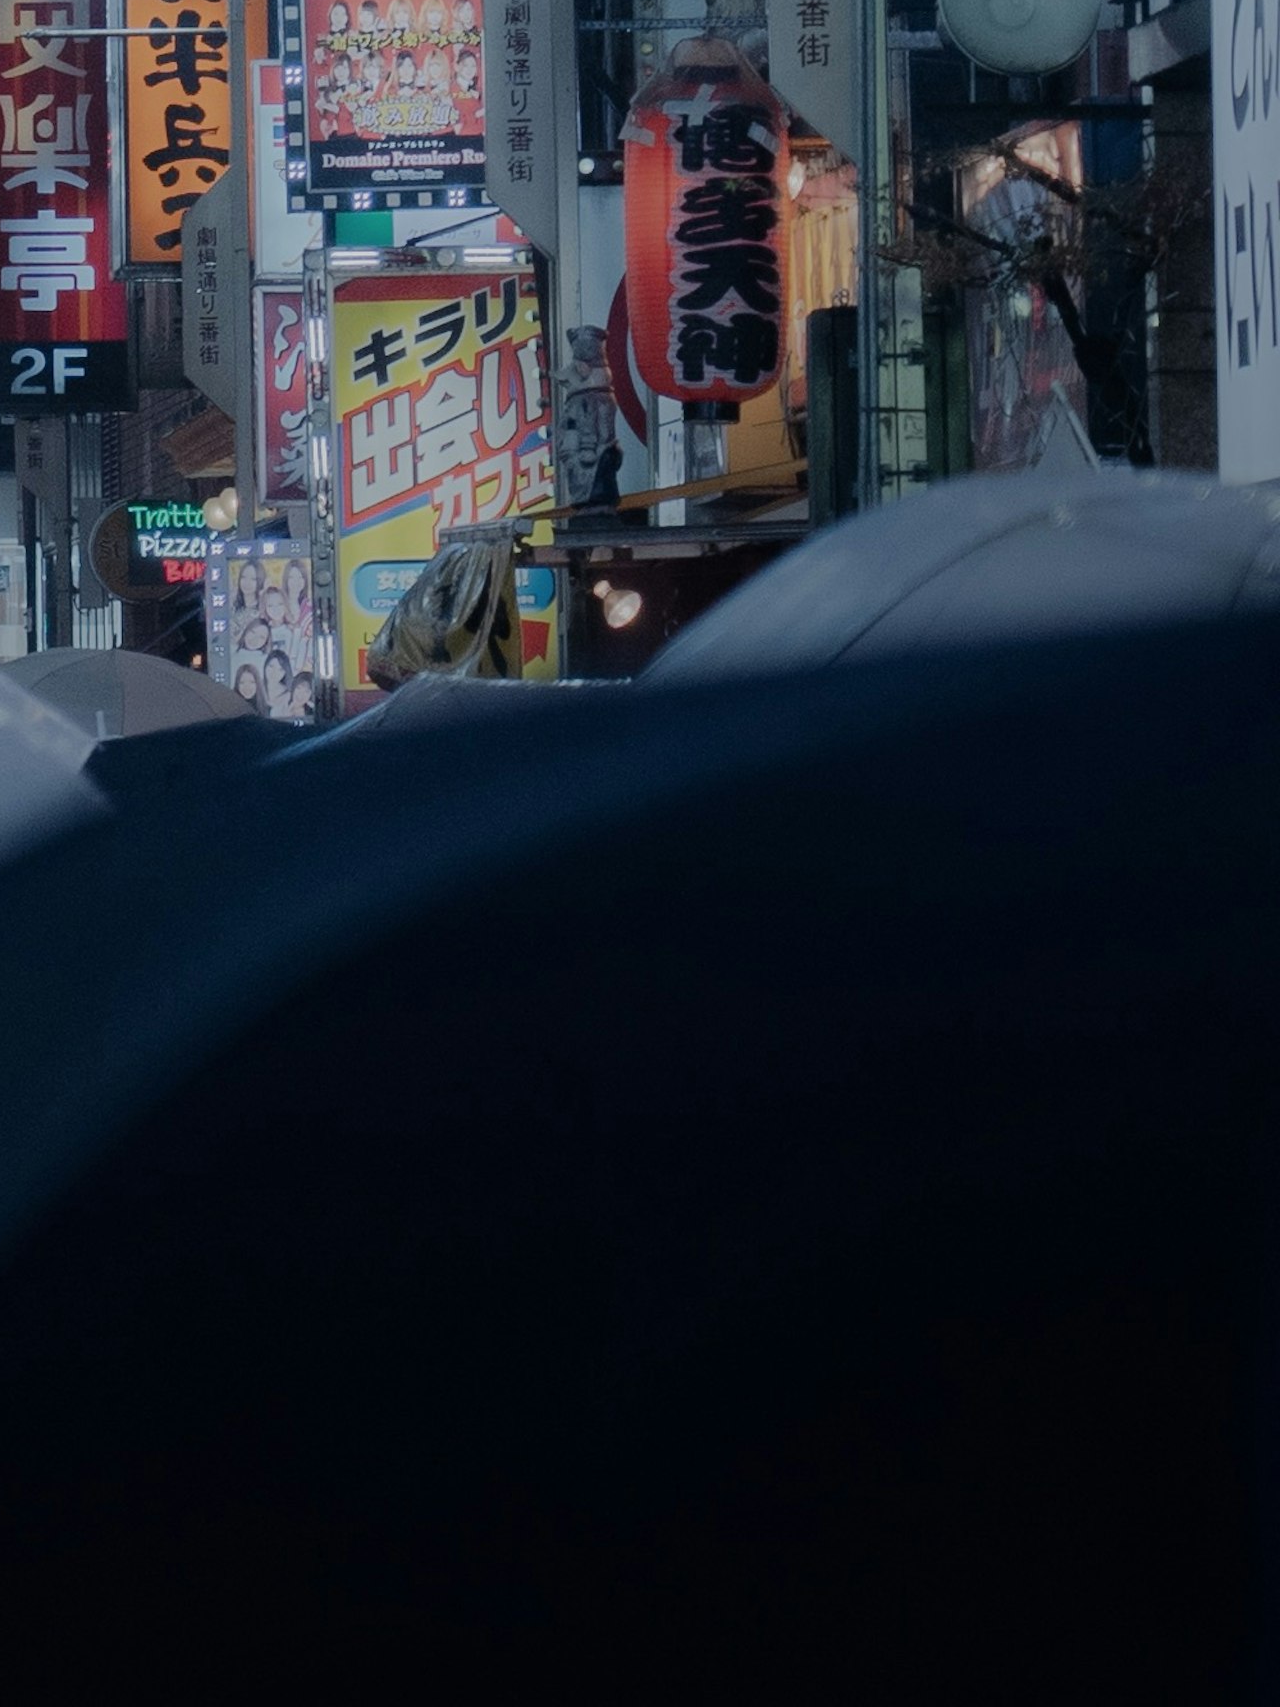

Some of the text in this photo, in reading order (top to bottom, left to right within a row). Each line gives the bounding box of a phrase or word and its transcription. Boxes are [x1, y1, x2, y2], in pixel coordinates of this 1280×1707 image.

[504, 0, 535, 184] 劇場通り一番街
[195, 224, 221, 368] 劇場通り一番街
[673, 100, 783, 384] 博多天神
[9, 346, 89, 396] 2F
[353, 275, 523, 389] キラリ
[348, 343, 546, 521] 出会い
